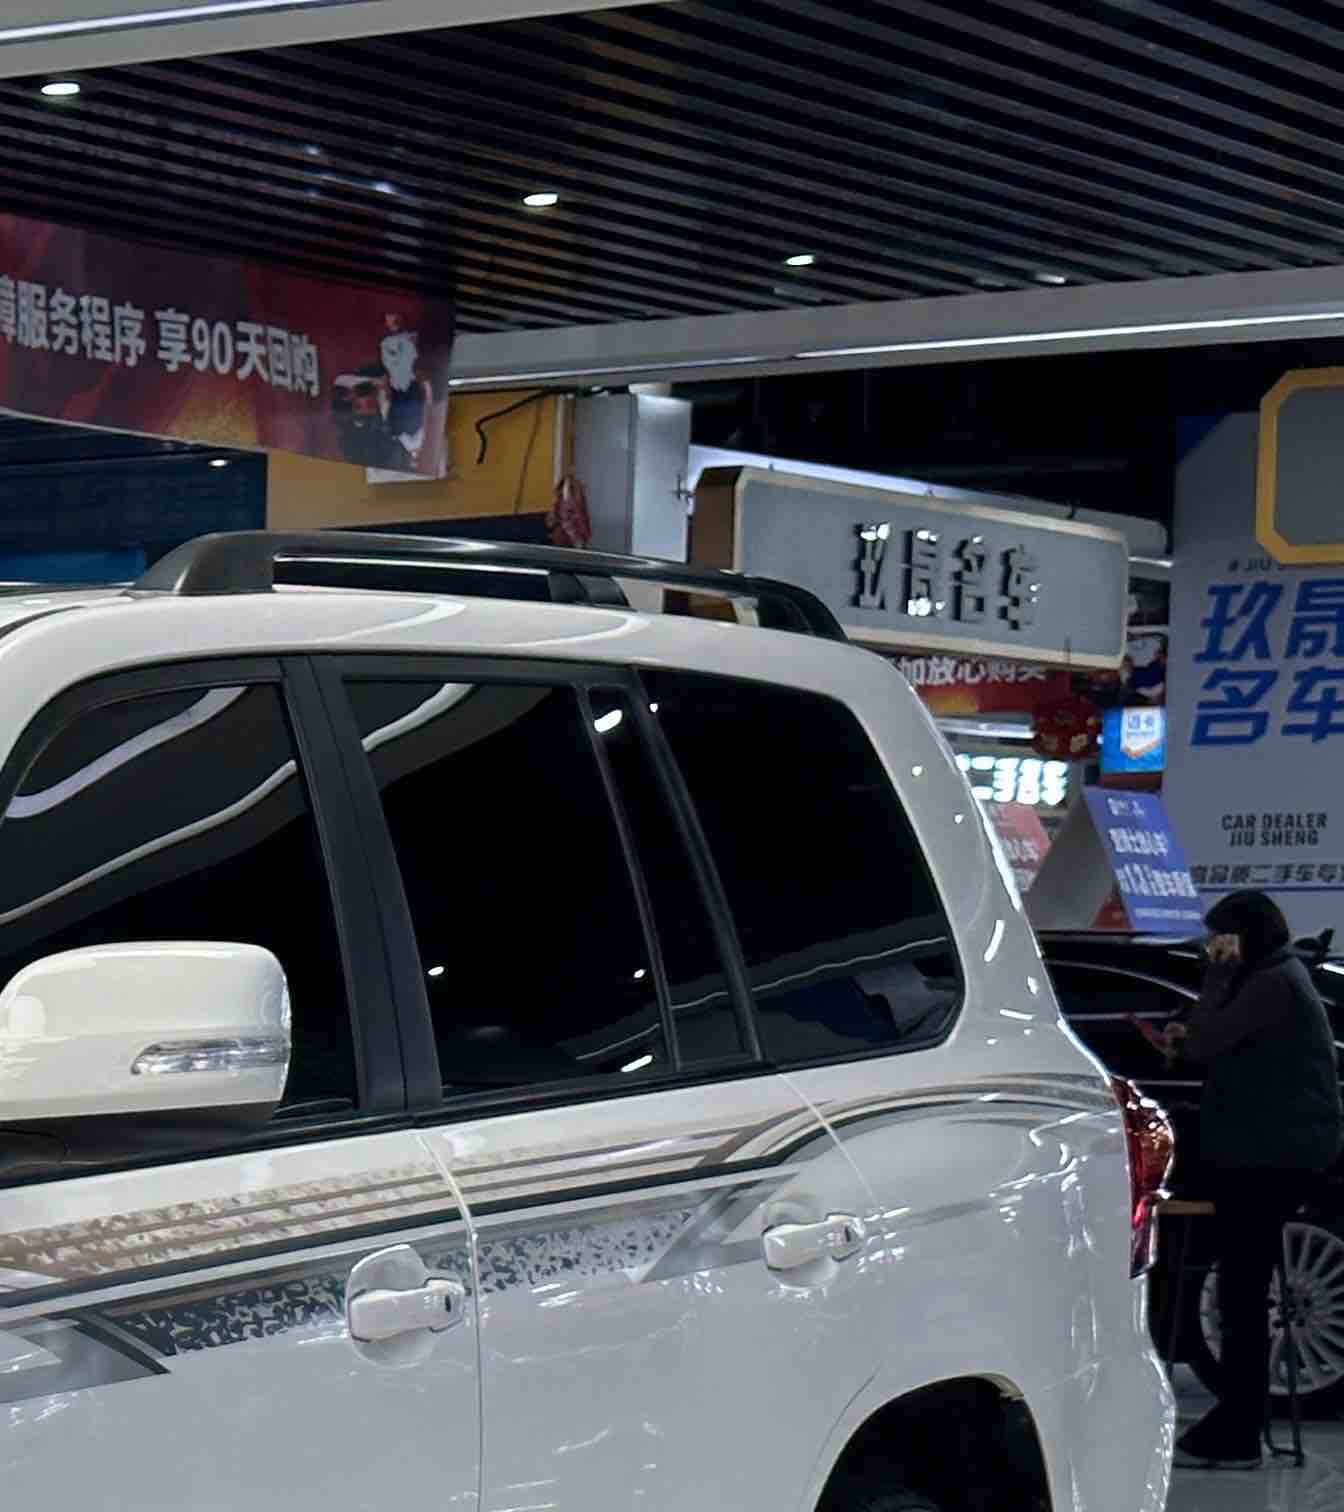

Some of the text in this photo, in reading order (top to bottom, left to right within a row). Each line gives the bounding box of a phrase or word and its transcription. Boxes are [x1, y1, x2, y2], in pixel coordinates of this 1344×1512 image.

[155, 308, 321, 397] 享90天回购
[1190, 666, 1344, 746] 名车
[955, 753, 1069, 807] 二手名车
[1221, 812, 1329, 831] CAR DEALER
[1230, 831, 1255, 847] JIU
